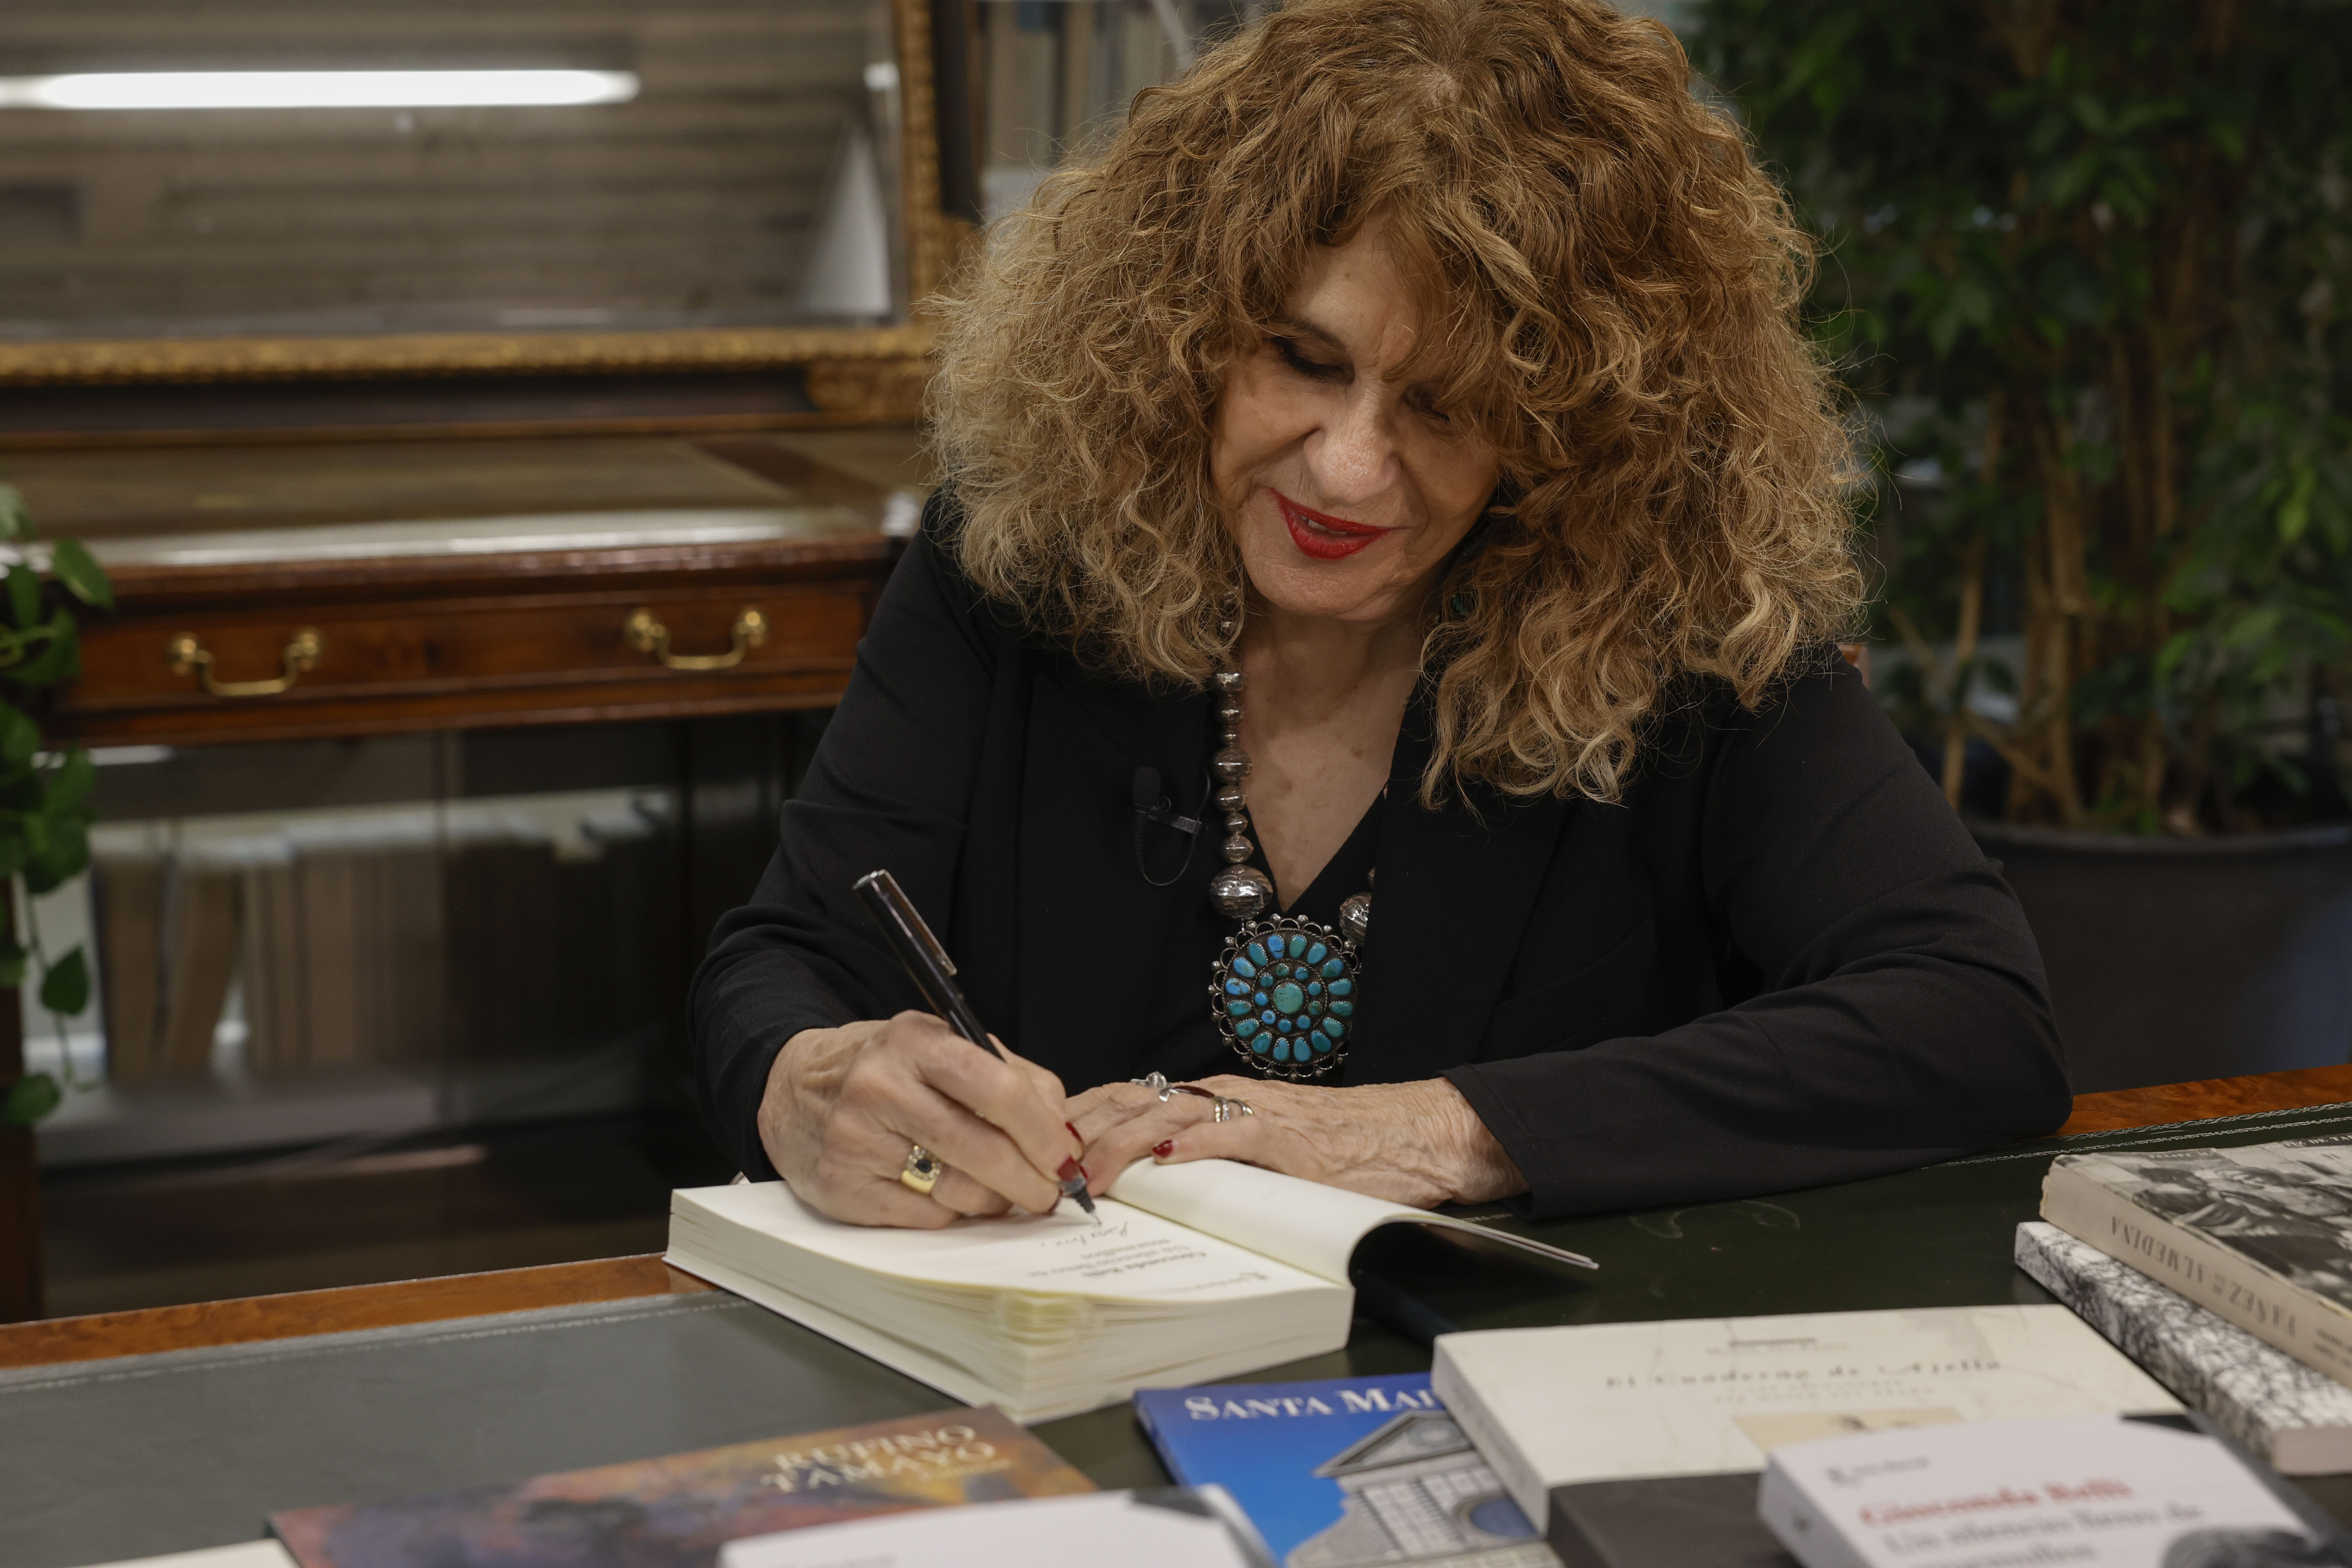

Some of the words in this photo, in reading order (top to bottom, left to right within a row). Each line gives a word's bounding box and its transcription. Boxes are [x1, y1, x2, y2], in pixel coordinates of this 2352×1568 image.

[2111, 1216, 2203, 1283] ALMEDINA
[1654, 1368, 1809, 1385] Cuaderno
[1827, 1364, 1859, 1378] de
[1184, 1396, 1333, 1421] SANTA
[760, 1441, 996, 1493] TAMAYO
[775, 1425, 977, 1471] RUFINO
